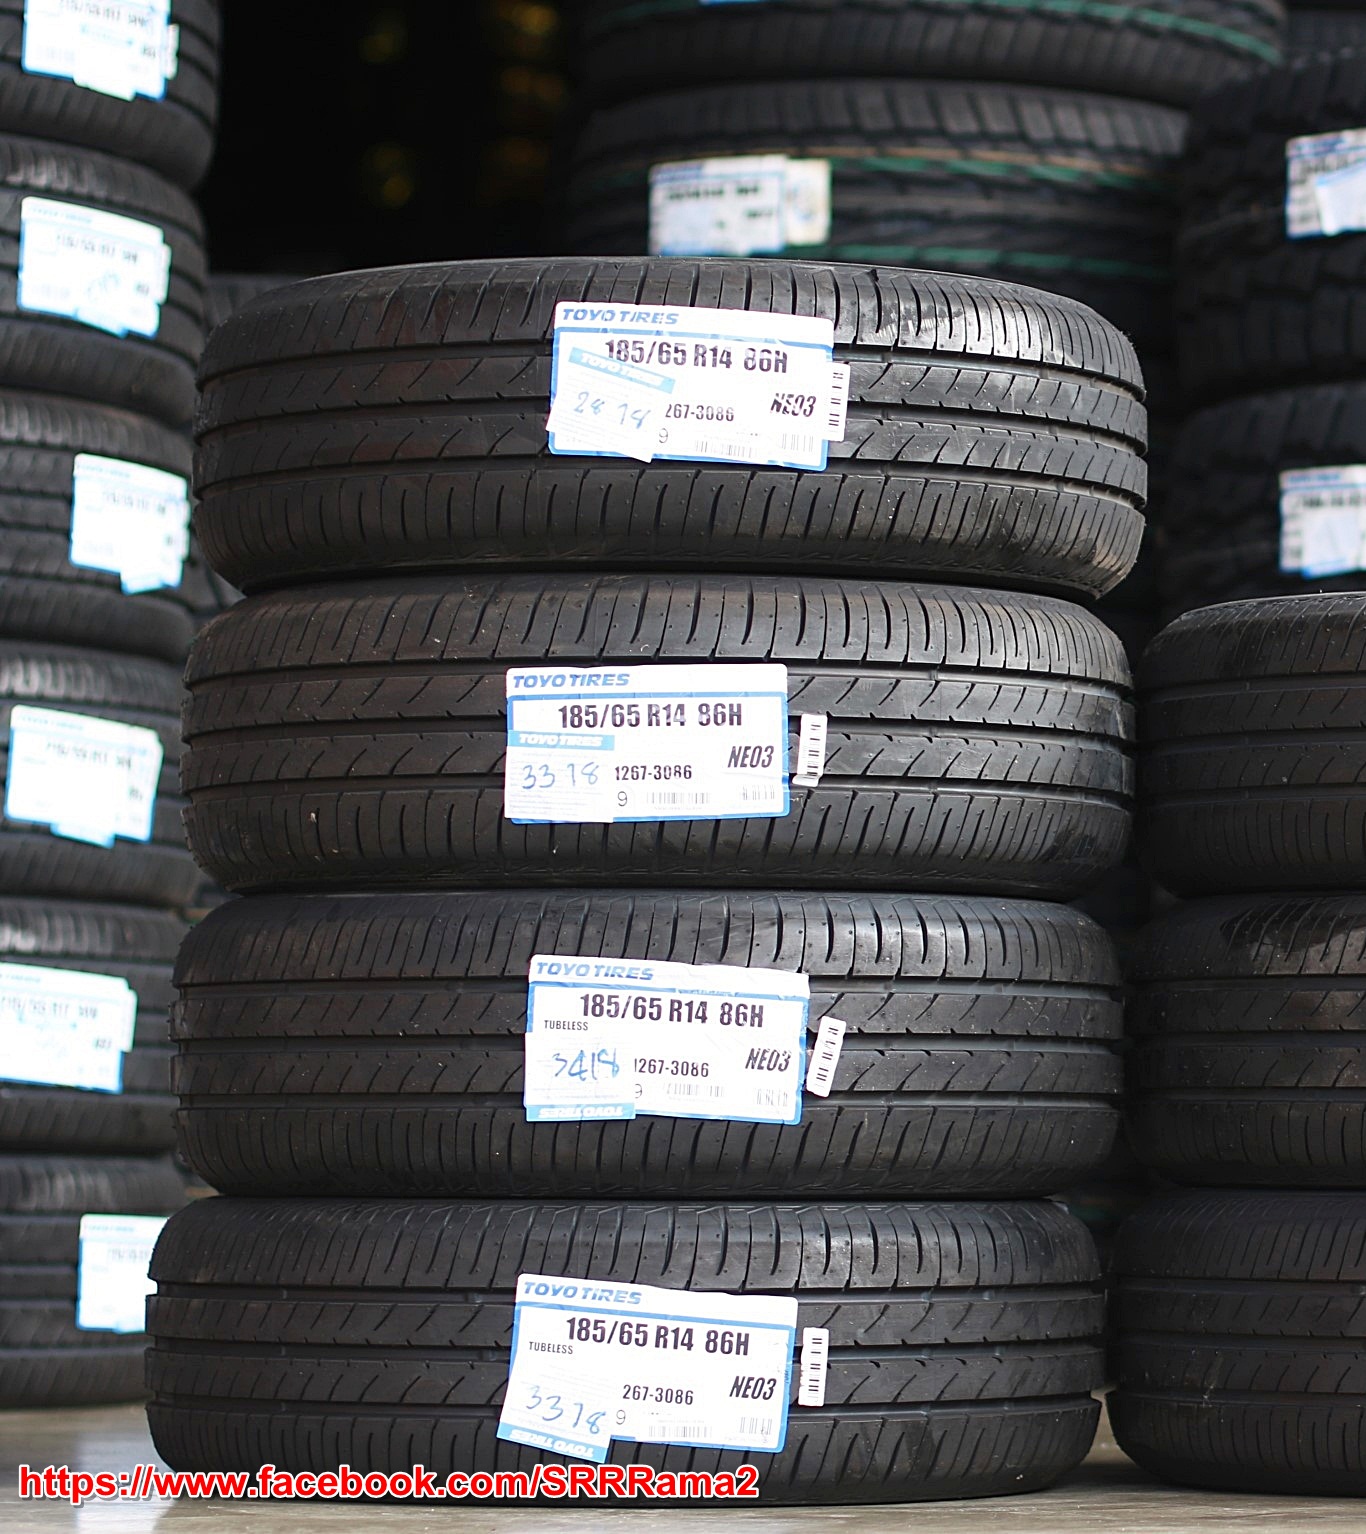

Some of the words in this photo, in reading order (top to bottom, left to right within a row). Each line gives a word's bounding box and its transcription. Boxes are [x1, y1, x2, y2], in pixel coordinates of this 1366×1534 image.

[562, 308, 616, 322] TOYO
[620, 310, 680, 325] TIRES
[605, 339, 687, 366] 185/65
[693, 346, 732, 370] R14
[743, 348, 788, 373] 86H
[658, 427, 669, 444] 9
[513, 674, 566, 689] TOYO
[570, 673, 631, 687] TIRES
[558, 703, 641, 729] 185/65
[648, 703, 687, 727] R14
[697, 703, 743, 727] 86H
[614, 765, 693, 782] 1267-3086
[617, 790, 628, 807] 9
[537, 962, 591, 978] TOYO
[595, 964, 654, 981] TIRES
[580, 993, 662, 1021] 185/65
[669, 998, 708, 1024] R14
[719, 1002, 764, 1028] 86H
[544, 1020, 589, 1031] TUBELESS
[523, 1281, 578, 1298] TOYO
[582, 1287, 642, 1305] TIRES
[566, 1317, 649, 1347] 185/65
[654, 1326, 694, 1352] R14
[704, 1330, 750, 1356] 86H
[529, 1341, 574, 1355] TUBELESS
[622, 1384, 694, 1406] 267-3086
[615, 1409, 626, 1425] 9
